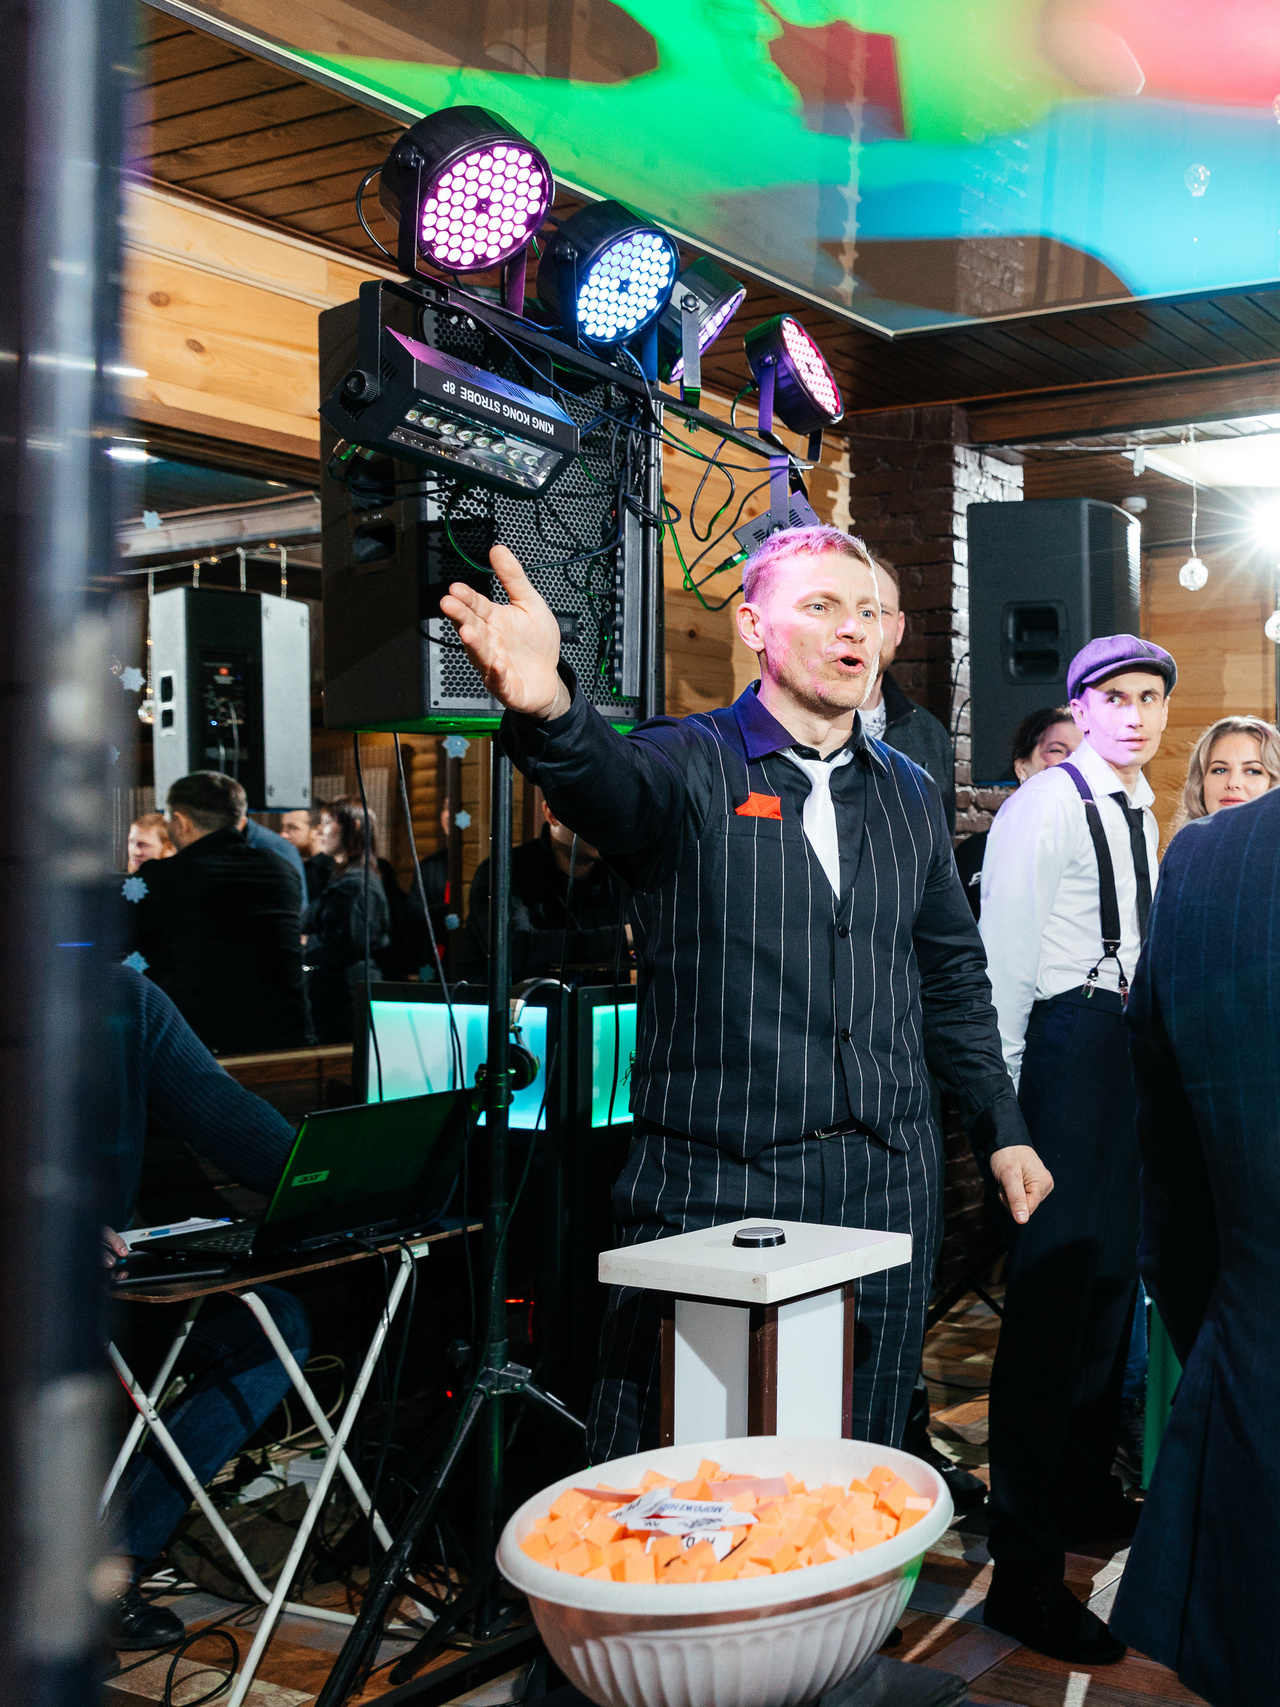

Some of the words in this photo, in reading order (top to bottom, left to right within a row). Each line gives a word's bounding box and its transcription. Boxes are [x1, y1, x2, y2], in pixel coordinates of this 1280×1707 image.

[442, 380, 456, 395] 8P
[460, 386, 501, 414] STROBE
[502, 404, 530, 426] KONG
[532, 419, 555, 436] KING
